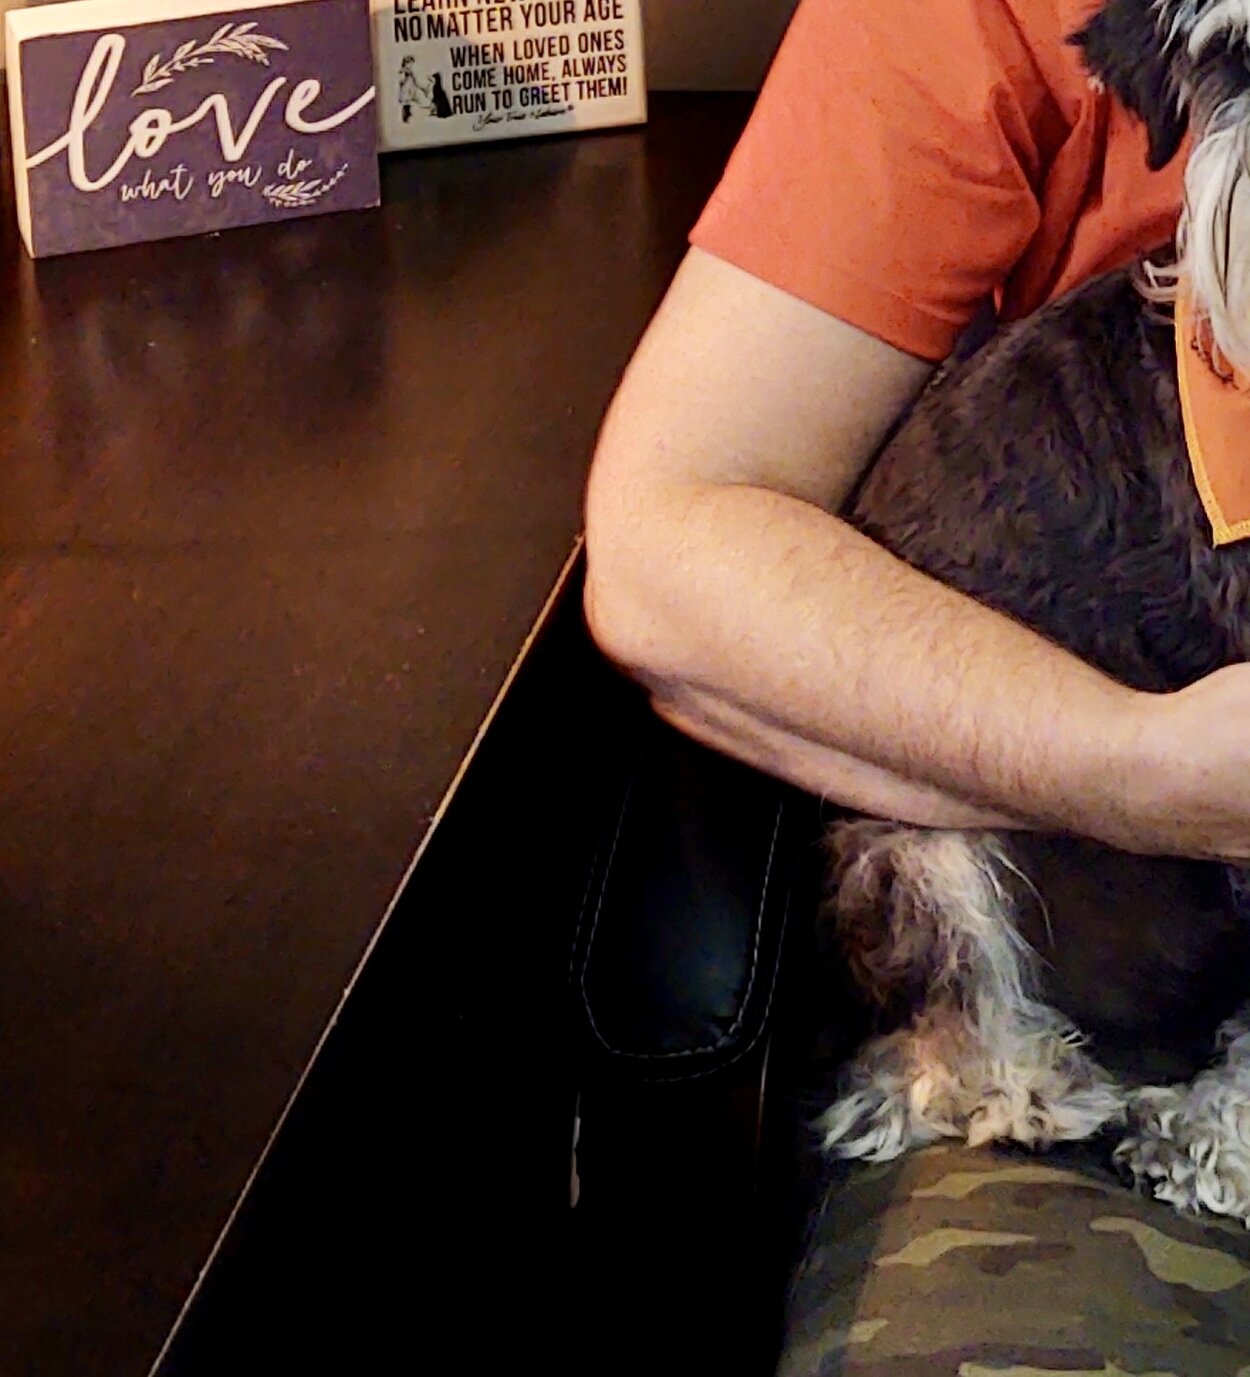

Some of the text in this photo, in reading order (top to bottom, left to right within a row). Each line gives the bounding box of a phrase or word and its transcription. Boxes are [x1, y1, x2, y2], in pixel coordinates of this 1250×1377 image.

[394, 15, 422, 43] NO
[427, 6, 513, 39] MATTER
[520, 0, 575, 29] YOUR
[450, 29, 624, 68] WHEN LOVED ONES
[452, 54, 627, 91] COME HOME, ALWAYS
[26, 33, 375, 192] love
[453, 76, 627, 115] RUN TO GREET THEM!
[120, 149, 313, 203] what you do
